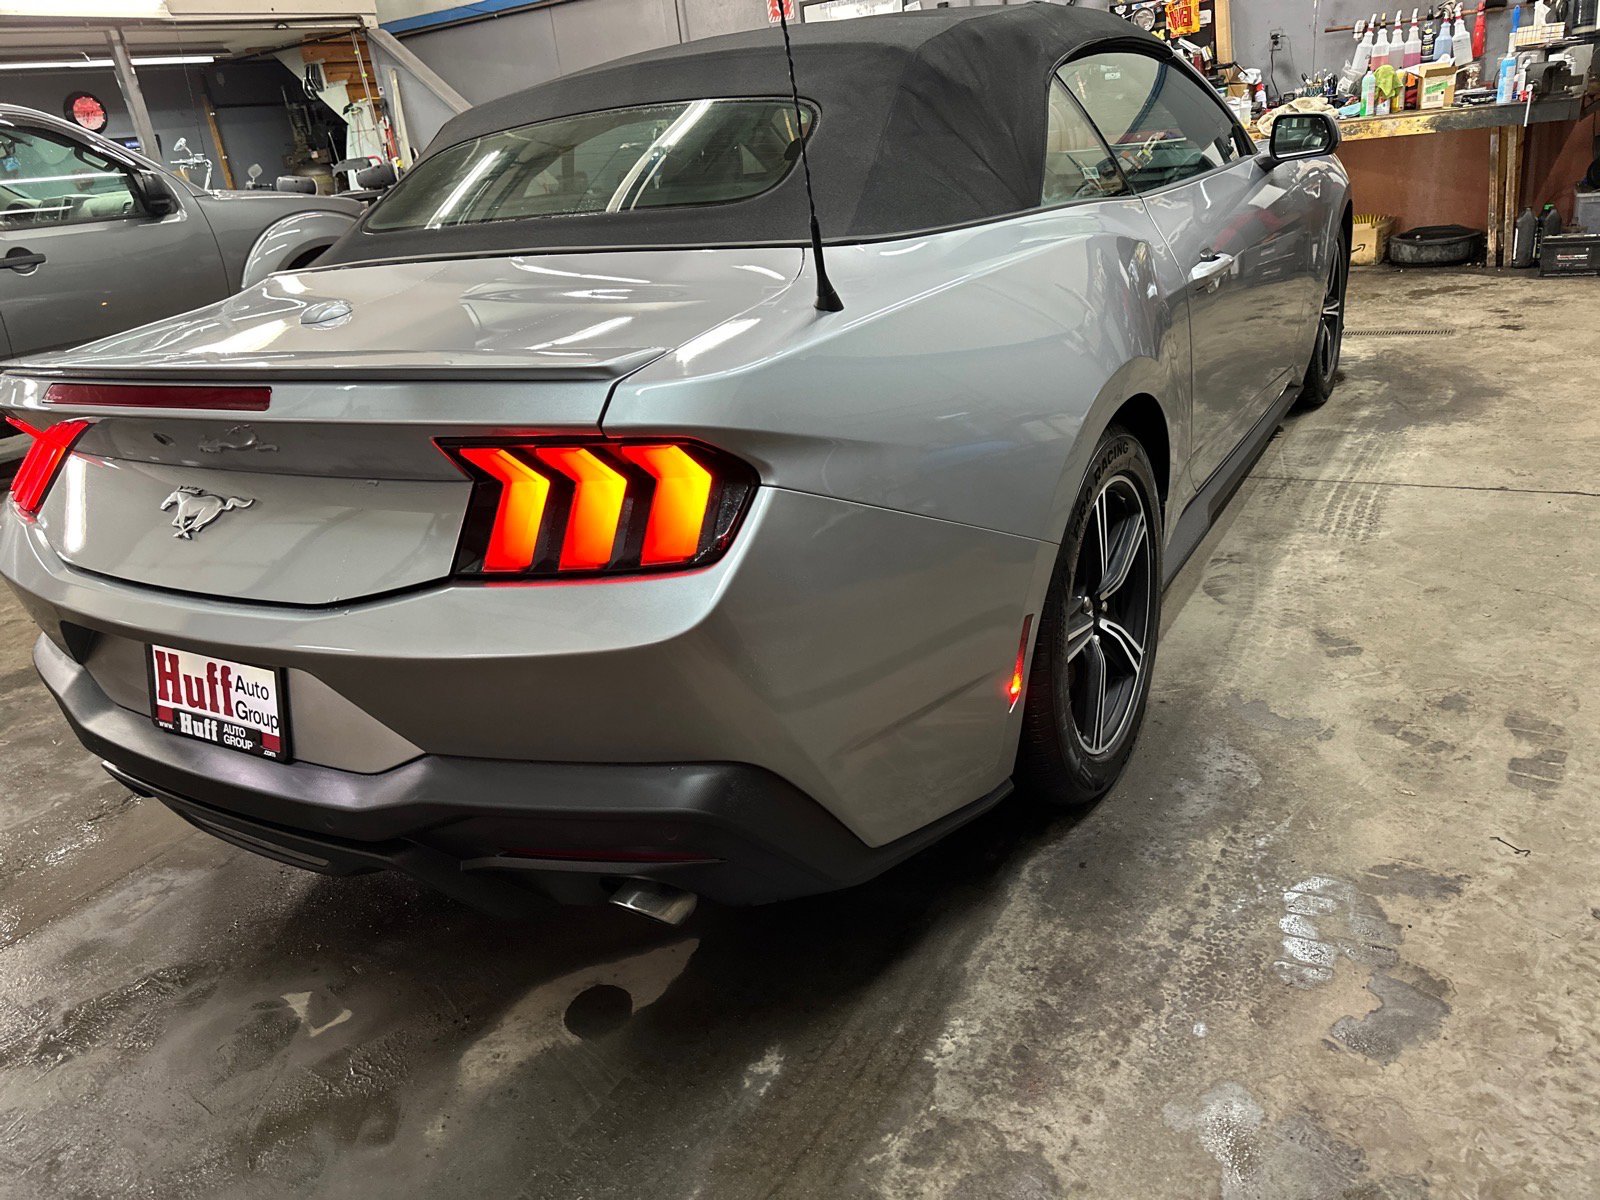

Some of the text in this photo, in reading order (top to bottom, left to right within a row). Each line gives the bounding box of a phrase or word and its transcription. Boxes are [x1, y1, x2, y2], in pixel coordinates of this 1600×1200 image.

[1074, 441, 1128, 540] PRO RACING
[154, 649, 234, 717] Huff
[235, 675, 269, 701] Auto
[179, 712, 218, 742] Huff
[223, 723, 246, 738] AUTO
[235, 700, 279, 733] Group
[223, 734, 253, 750] GROUP
